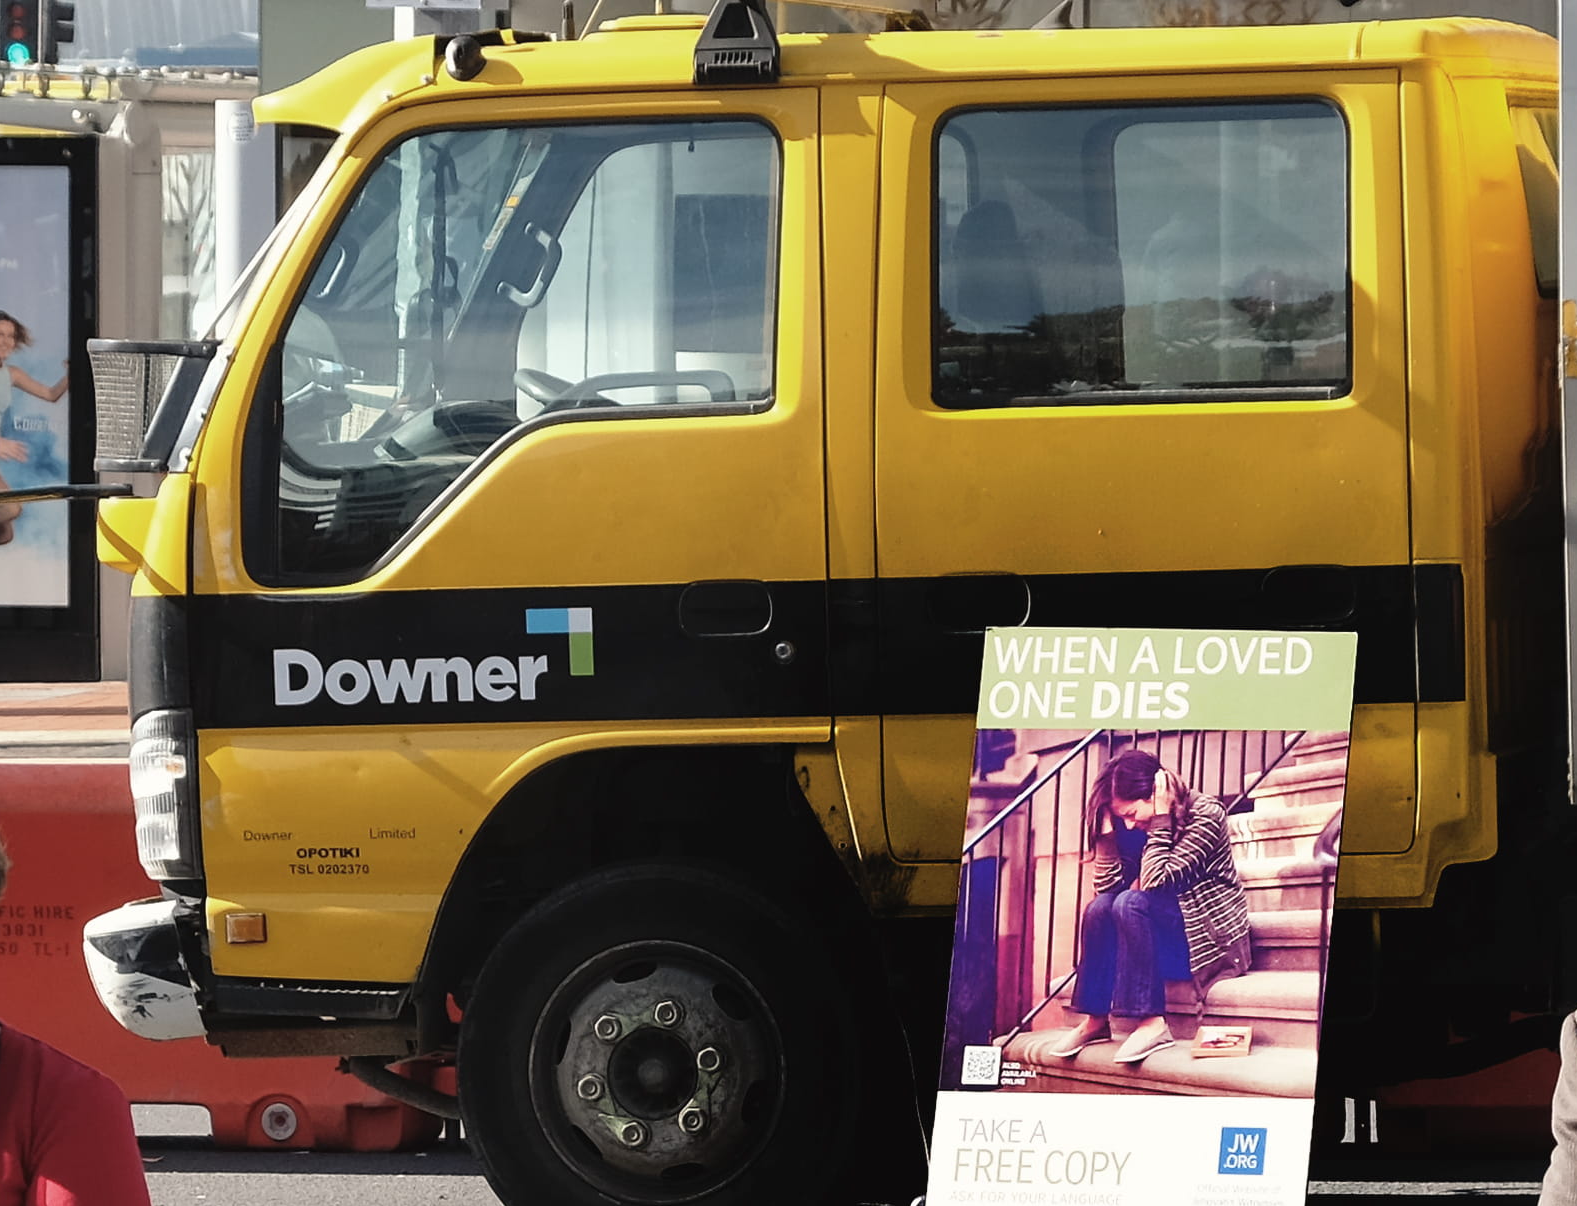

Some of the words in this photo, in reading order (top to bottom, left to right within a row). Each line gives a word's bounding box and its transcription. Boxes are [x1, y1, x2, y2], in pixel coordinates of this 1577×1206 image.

[994, 636, 1118, 675] WHEN
[1128, 636, 1160, 675] A
[1173, 636, 1313, 676] LOVED
[273, 648, 548, 706] Downer
[988, 680, 1080, 719] ONE
[1090, 681, 1190, 720] DIES
[243, 829, 293, 841] Downer
[369, 827, 416, 840] Limited
[296, 847, 360, 859] OPOTIKI
[289, 864, 314, 875] TSL
[317, 864, 370, 875] 0202370
[33, 905, 75, 920] HIRE
[958, 1118, 1023, 1143] TAKE
[1029, 1119, 1047, 1144] A
[1227, 1133, 1260, 1153] JW
[954, 1148, 1035, 1184] FREE
[1044, 1150, 1132, 1185] COPY
[1223, 1154, 1258, 1169] .ORG
[950, 1190, 974, 1203] ASK
[980, 1191, 1006, 1203] FOR
[1011, 1191, 1046, 1205] YOUR
[1051, 1192, 1123, 1206] LANGUAGE
